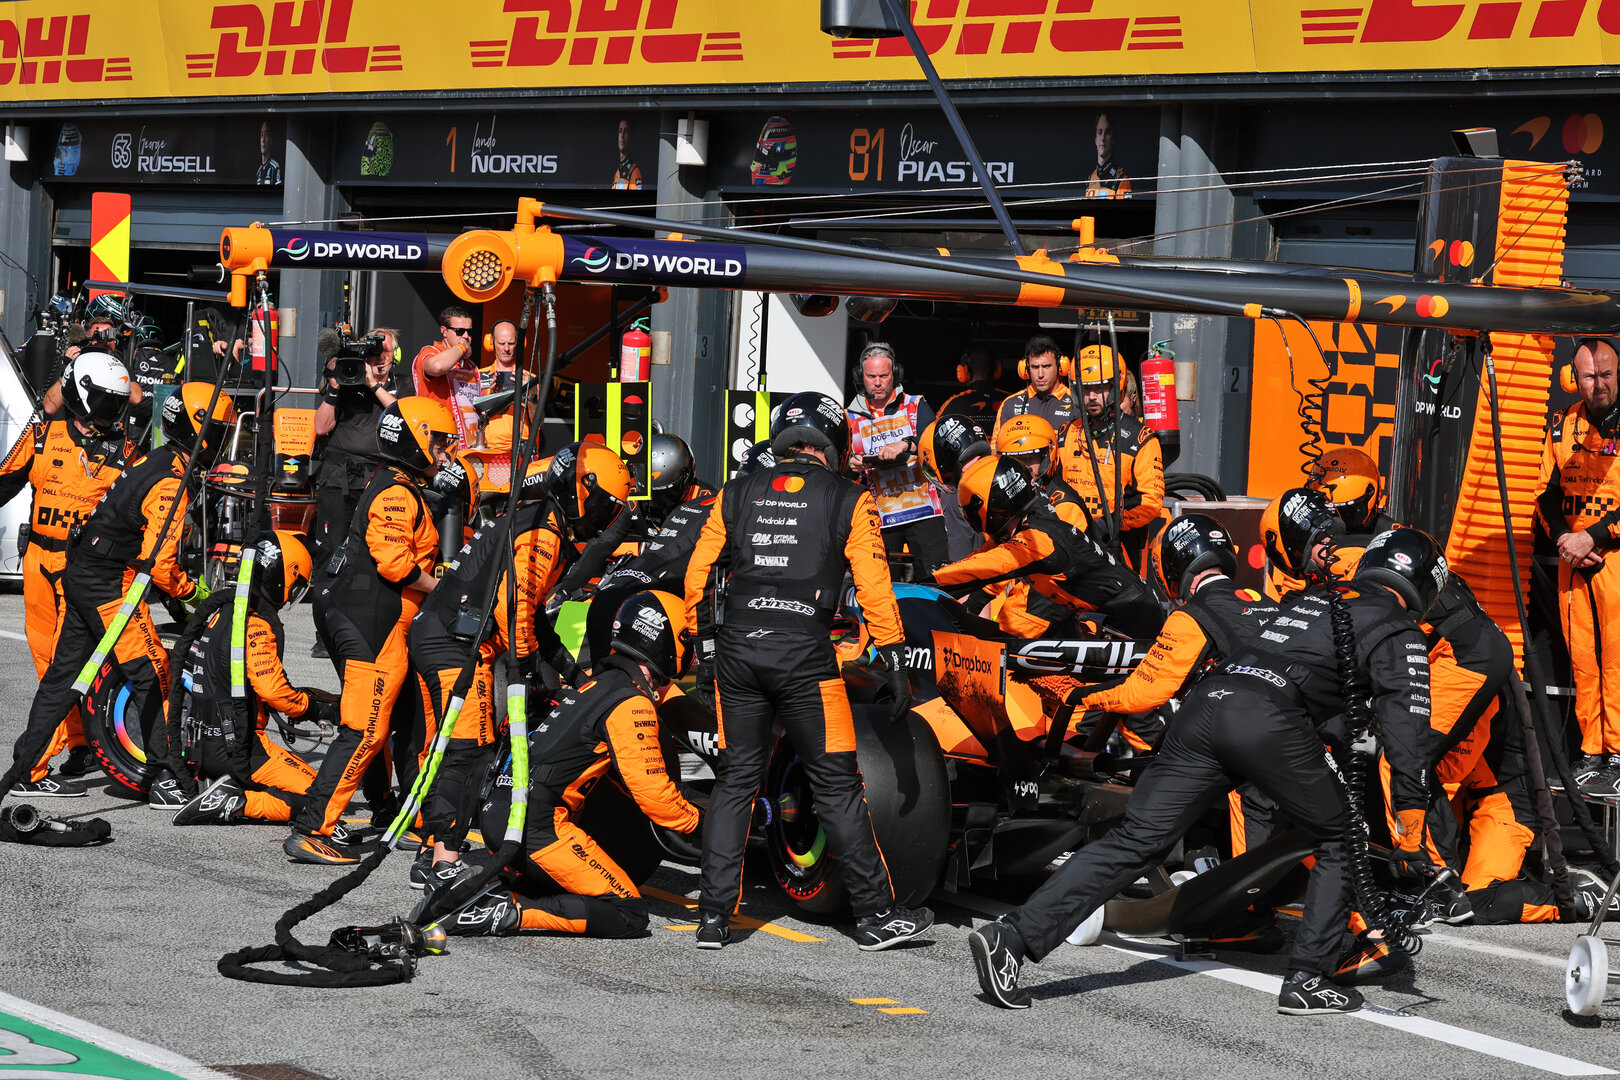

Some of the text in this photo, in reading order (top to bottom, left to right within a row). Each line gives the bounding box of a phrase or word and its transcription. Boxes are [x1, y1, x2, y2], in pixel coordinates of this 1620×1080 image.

[210, 0, 371, 77] DHL
[503, 0, 702, 67] DHL
[471, 115, 497, 157] Lando
[900, 122, 938, 161] Oscar
[111, 133, 132, 169] 63
[446, 126, 457, 173] 1
[848, 127, 886, 181] 81
[137, 156, 216, 173] RUSSELL
[471, 155, 558, 174] NORRIS
[897, 160, 1015, 184] PIASTRI
[314, 242, 422, 261] DP WORLD
[615, 252, 742, 277] DP WORLD
[701, 336, 708, 358] 3
[1230, 367, 1239, 393] 2
[1415, 400, 1462, 419] DP WRLD
[382, 413, 404, 432] ON
[938, 418, 957, 438] ON
[52, 445, 72, 454] Android
[999, 467, 1018, 489] ON
[1578, 475, 1615, 486] Technologies
[42, 487, 57, 496] DELL
[777, 500, 808, 509] WORLD
[1283, 492, 1303, 517] ON
[756, 515, 786, 526] Android
[1168, 519, 1190, 542] ON
[751, 532, 772, 546] ON
[754, 554, 789, 567] DEWALT
[634, 618, 660, 637] OPTIMUM
[638, 607, 668, 627] ON
[631, 623, 657, 642] NUTRITION
[140, 622, 157, 659] OPTIMUM
[155, 656, 170, 701] NUTRITION
[904, 645, 932, 671] em
[953, 652, 993, 675] Dropbox
[86, 659, 114, 715] P ZE
[477, 679, 488, 746] ON OPTIMUM
[343, 677, 386, 782] ON OPTIMUM NUTRITION
[633, 720, 657, 729] DEWALT
[284, 756, 300, 770] ON
[1020, 781, 1039, 799] groq
[570, 843, 625, 894] ON OPTIMUM
